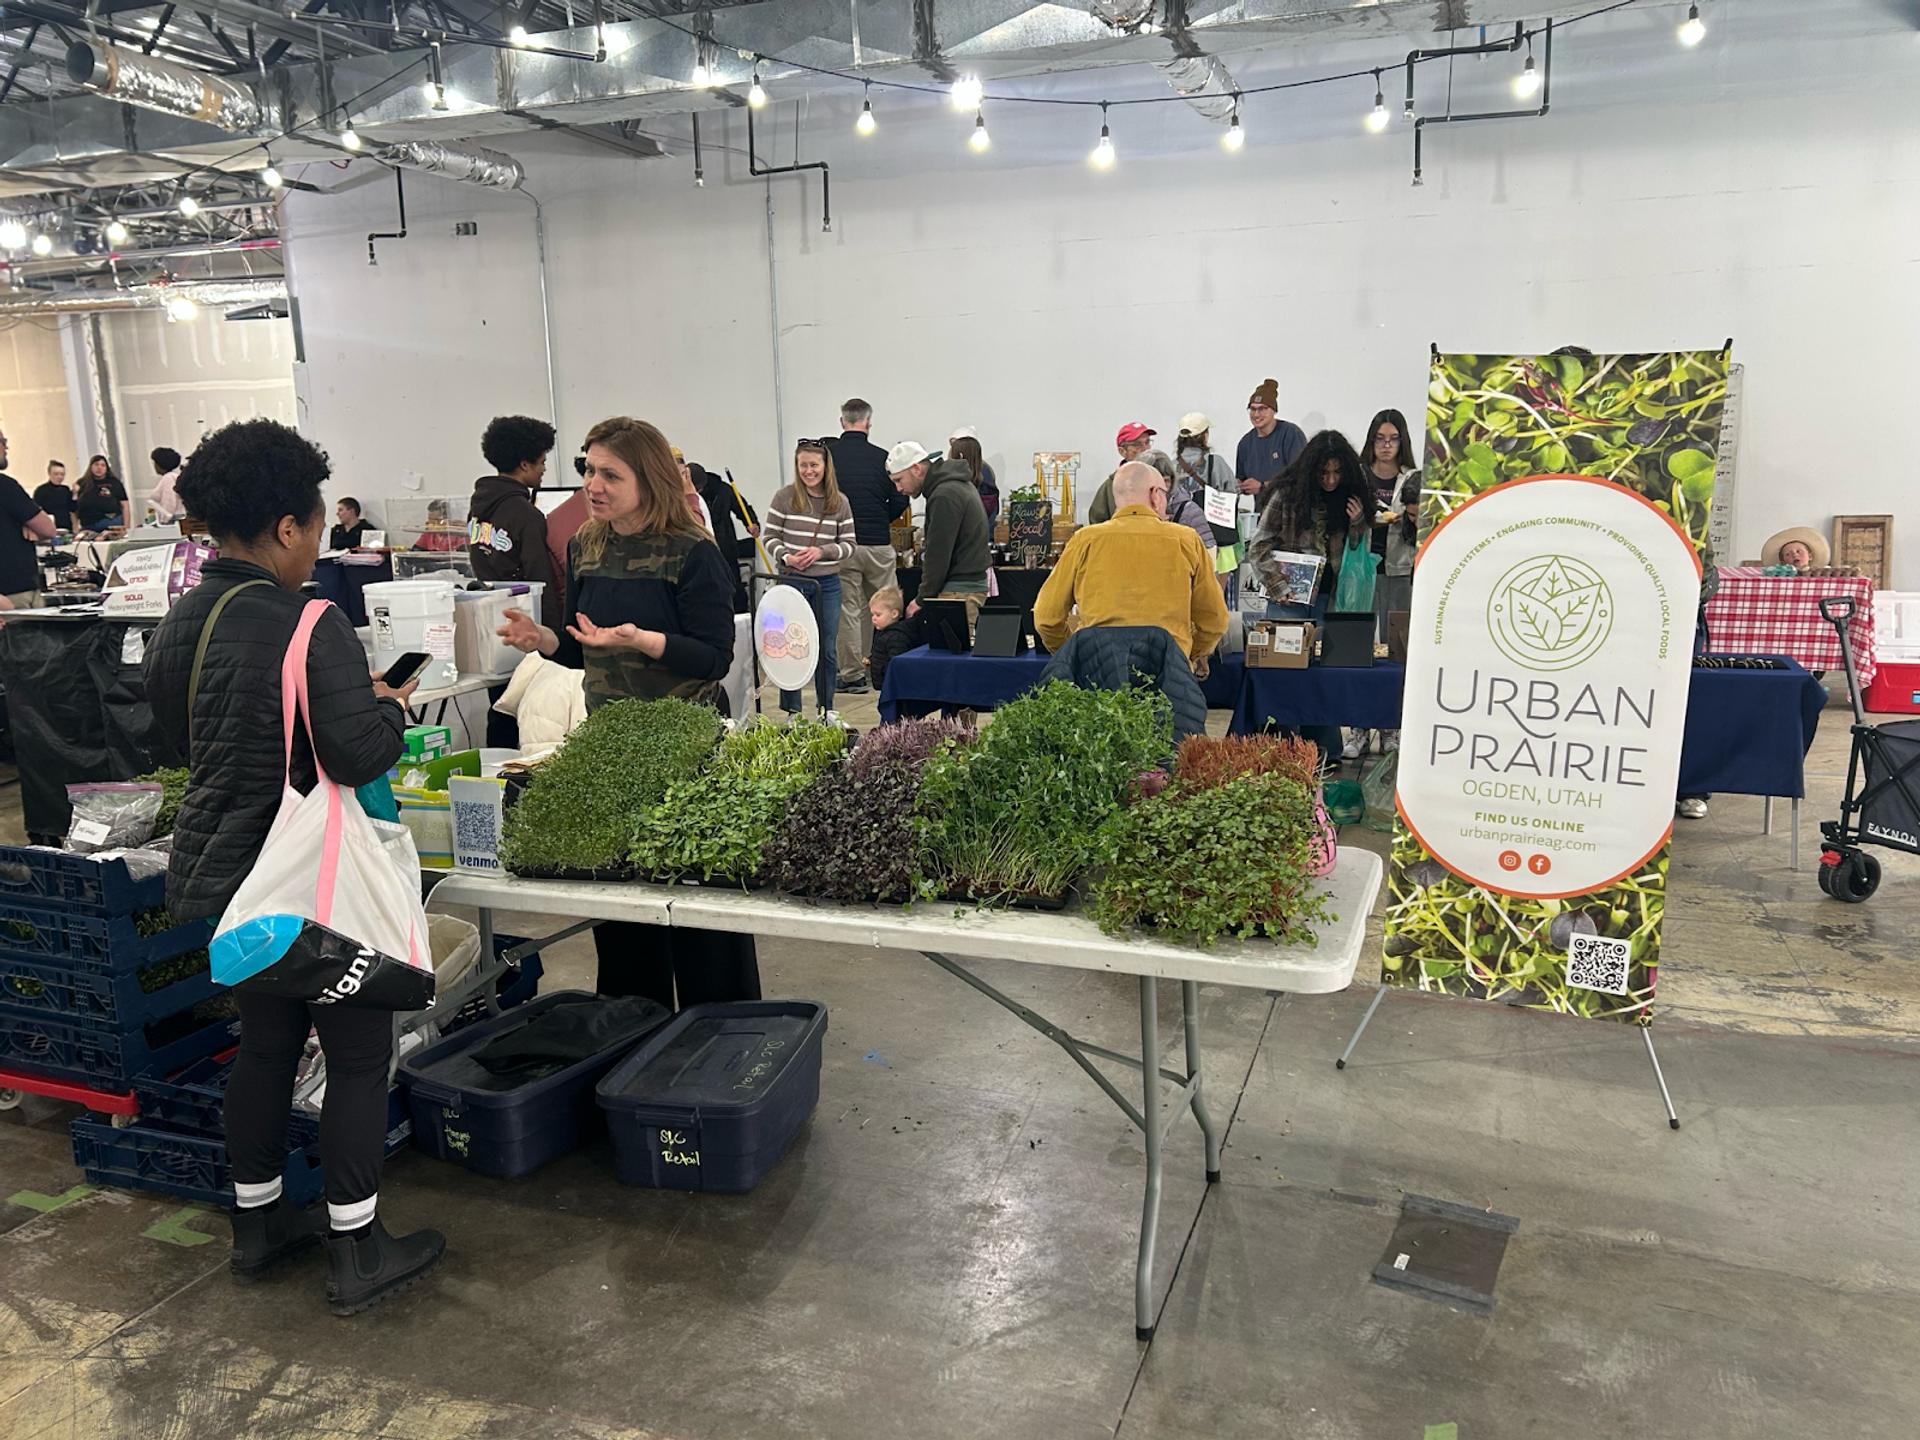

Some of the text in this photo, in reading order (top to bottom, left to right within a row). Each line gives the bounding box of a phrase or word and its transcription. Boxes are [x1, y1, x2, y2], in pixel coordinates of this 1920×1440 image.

[1010, 520, 1044, 538] Local
[1434, 517, 1671, 659] SUSTAINABLE FOOD SYSTEMS ENGAGING COMMUNITY PROVIDING QUALITY LOCAL FOODS
[1436, 667, 1655, 739] URBAN
[1430, 724, 1648, 786] PRAIRIE
[1462, 779, 1603, 809] OGDEN, UTAH
[1474, 811, 1585, 833] FIND US ONLINE
[1460, 827, 1597, 852] urbanprairieag.com
[459, 856, 498, 869] venmo
[661, 1151, 700, 1166] Retail
